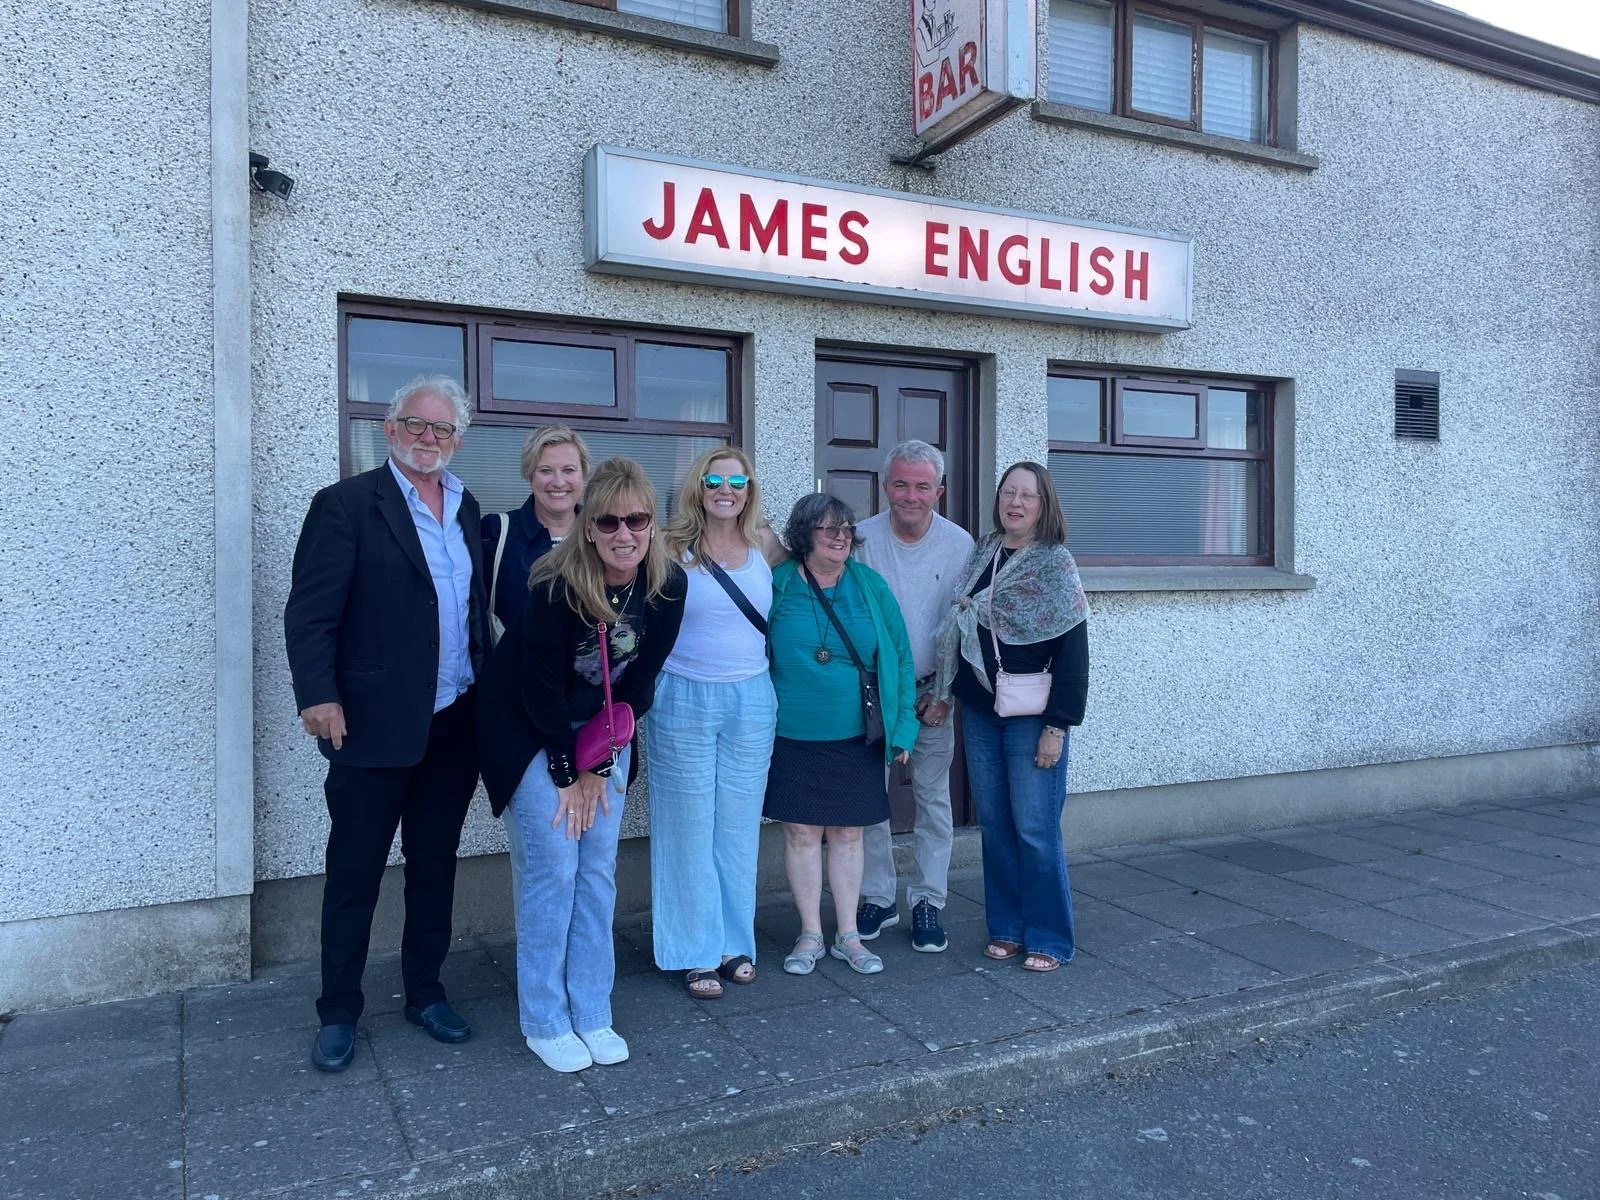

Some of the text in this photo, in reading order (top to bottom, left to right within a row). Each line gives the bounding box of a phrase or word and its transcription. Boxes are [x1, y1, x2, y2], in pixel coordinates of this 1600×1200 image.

[919, 41, 979, 122] BAR
[642, 181, 1149, 300] JAMES ENGLISH
